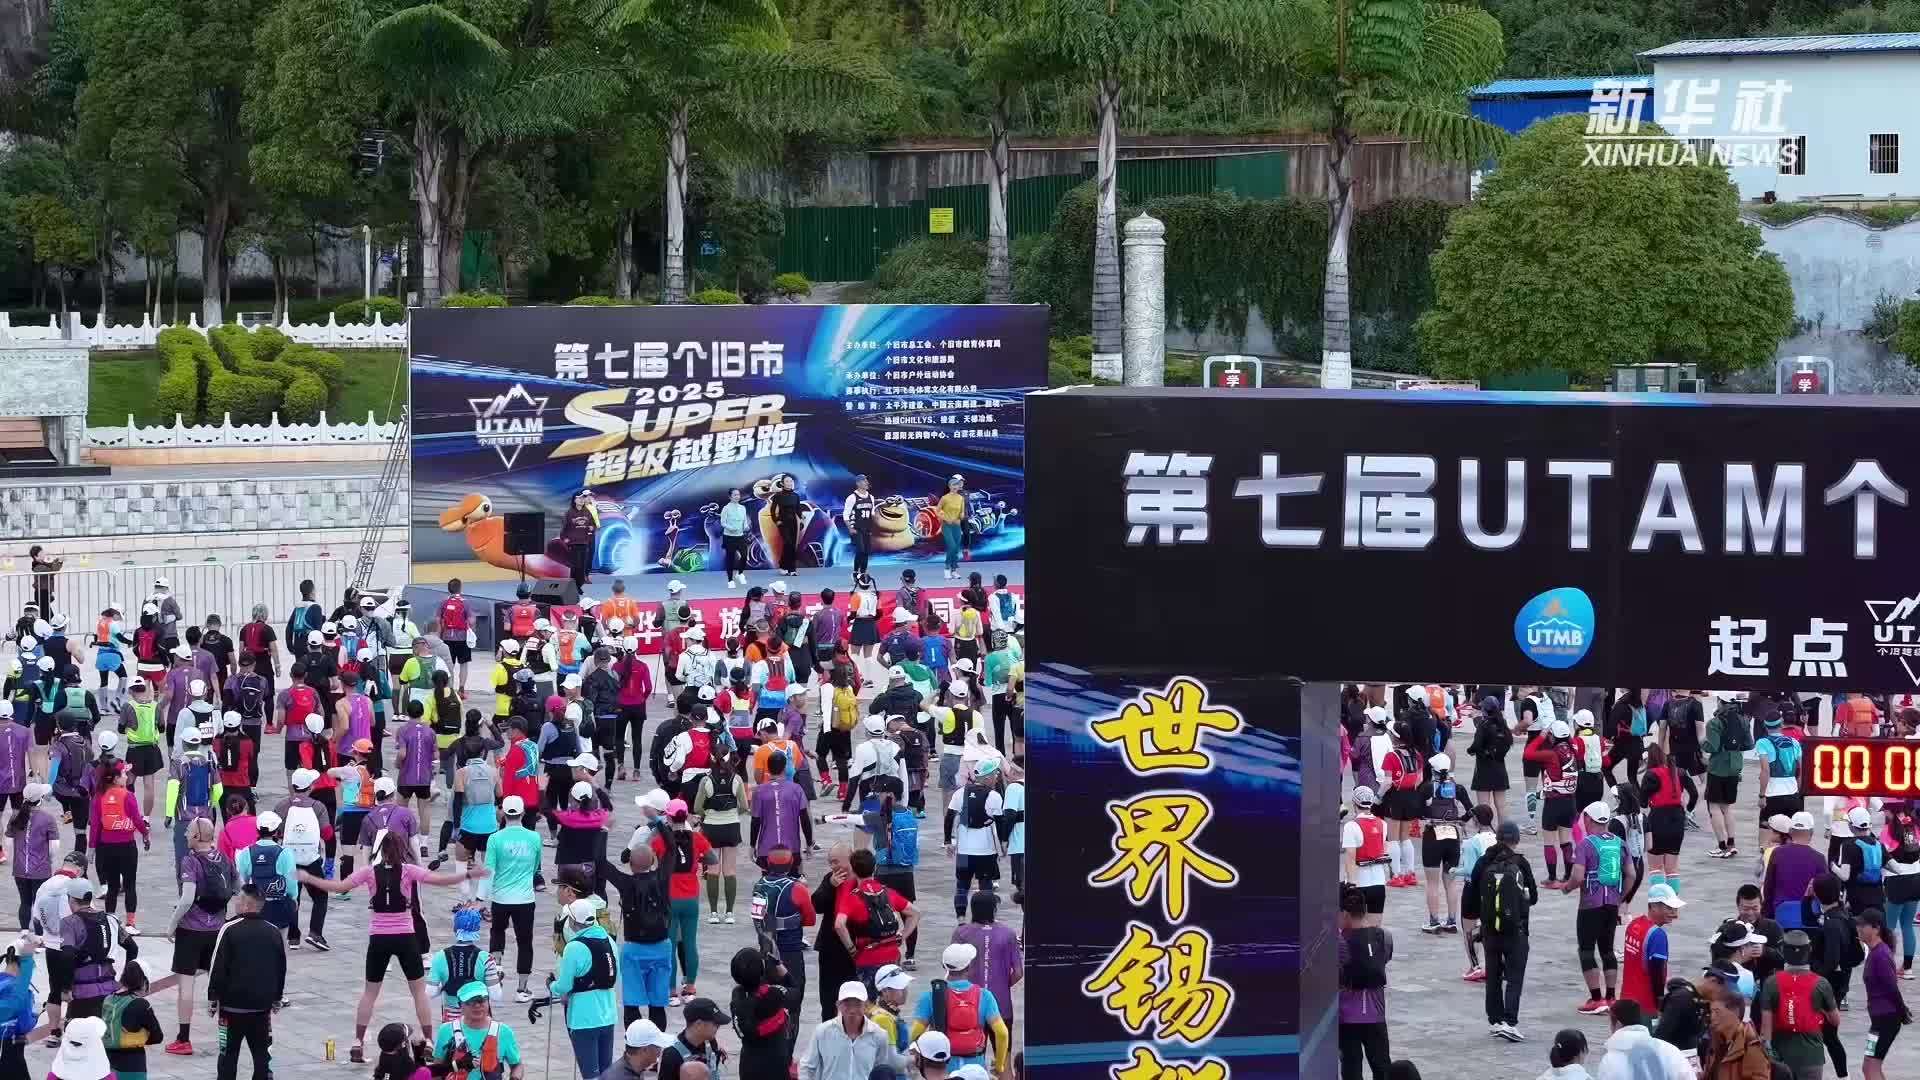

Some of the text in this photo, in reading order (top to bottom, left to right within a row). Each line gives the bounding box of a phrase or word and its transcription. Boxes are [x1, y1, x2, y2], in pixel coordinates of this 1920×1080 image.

[554, 340, 785, 381] 第七届个旧市
[635, 380, 725, 406] 2025
[475, 417, 544, 434] UTAM
[547, 388, 787, 460] SUPER
[583, 421, 798, 487] 超级越野跑
[1527, 628, 1584, 646] UTMB
[1708, 616, 1849, 678] 起点
[1873, 624, 1920, 643] UT
[1813, 744, 1920, 792] 00 0
